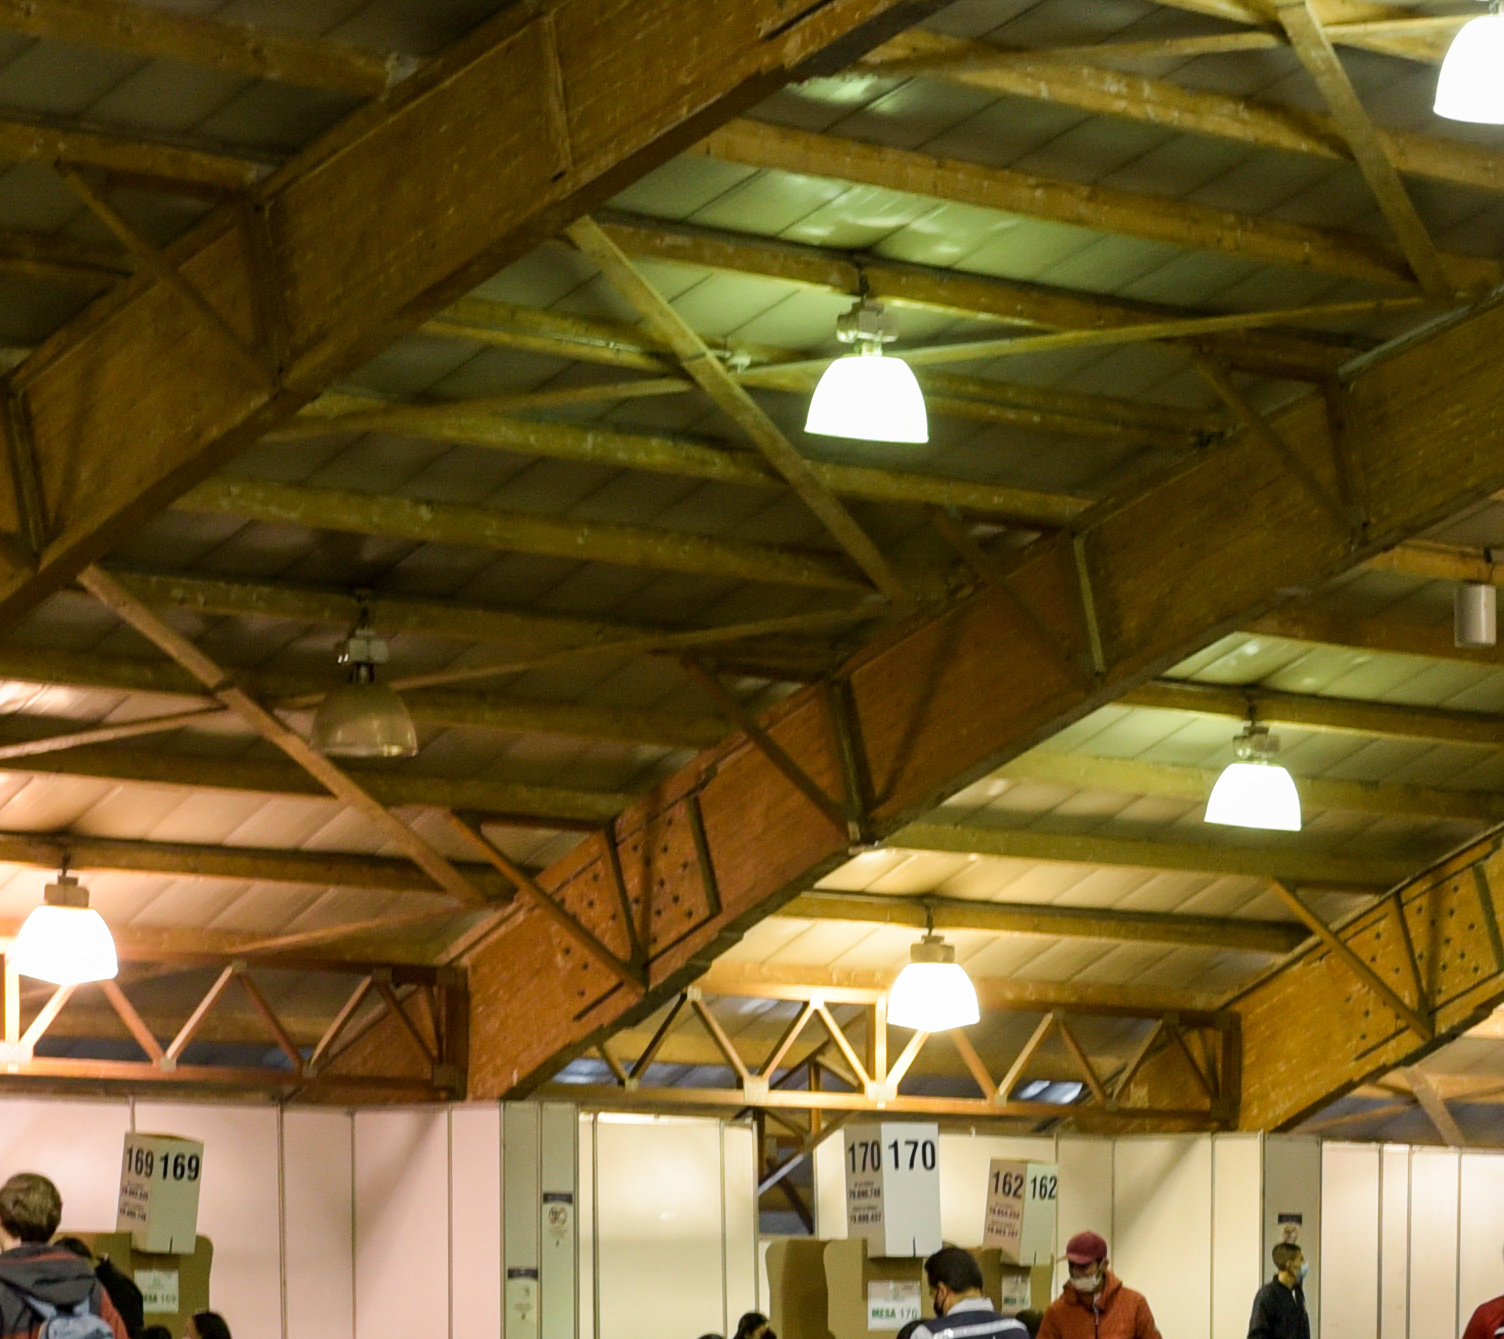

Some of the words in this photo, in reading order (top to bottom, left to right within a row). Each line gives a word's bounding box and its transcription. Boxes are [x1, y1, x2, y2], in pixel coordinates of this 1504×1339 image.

[126, 1144, 155, 1179] 169
[158, 1152, 201, 1182] 169
[848, 1140, 882, 1174] 170
[887, 1139, 937, 1172] 170
[993, 1170, 1025, 1200] 162
[1030, 1175, 1058, 1201] 162
